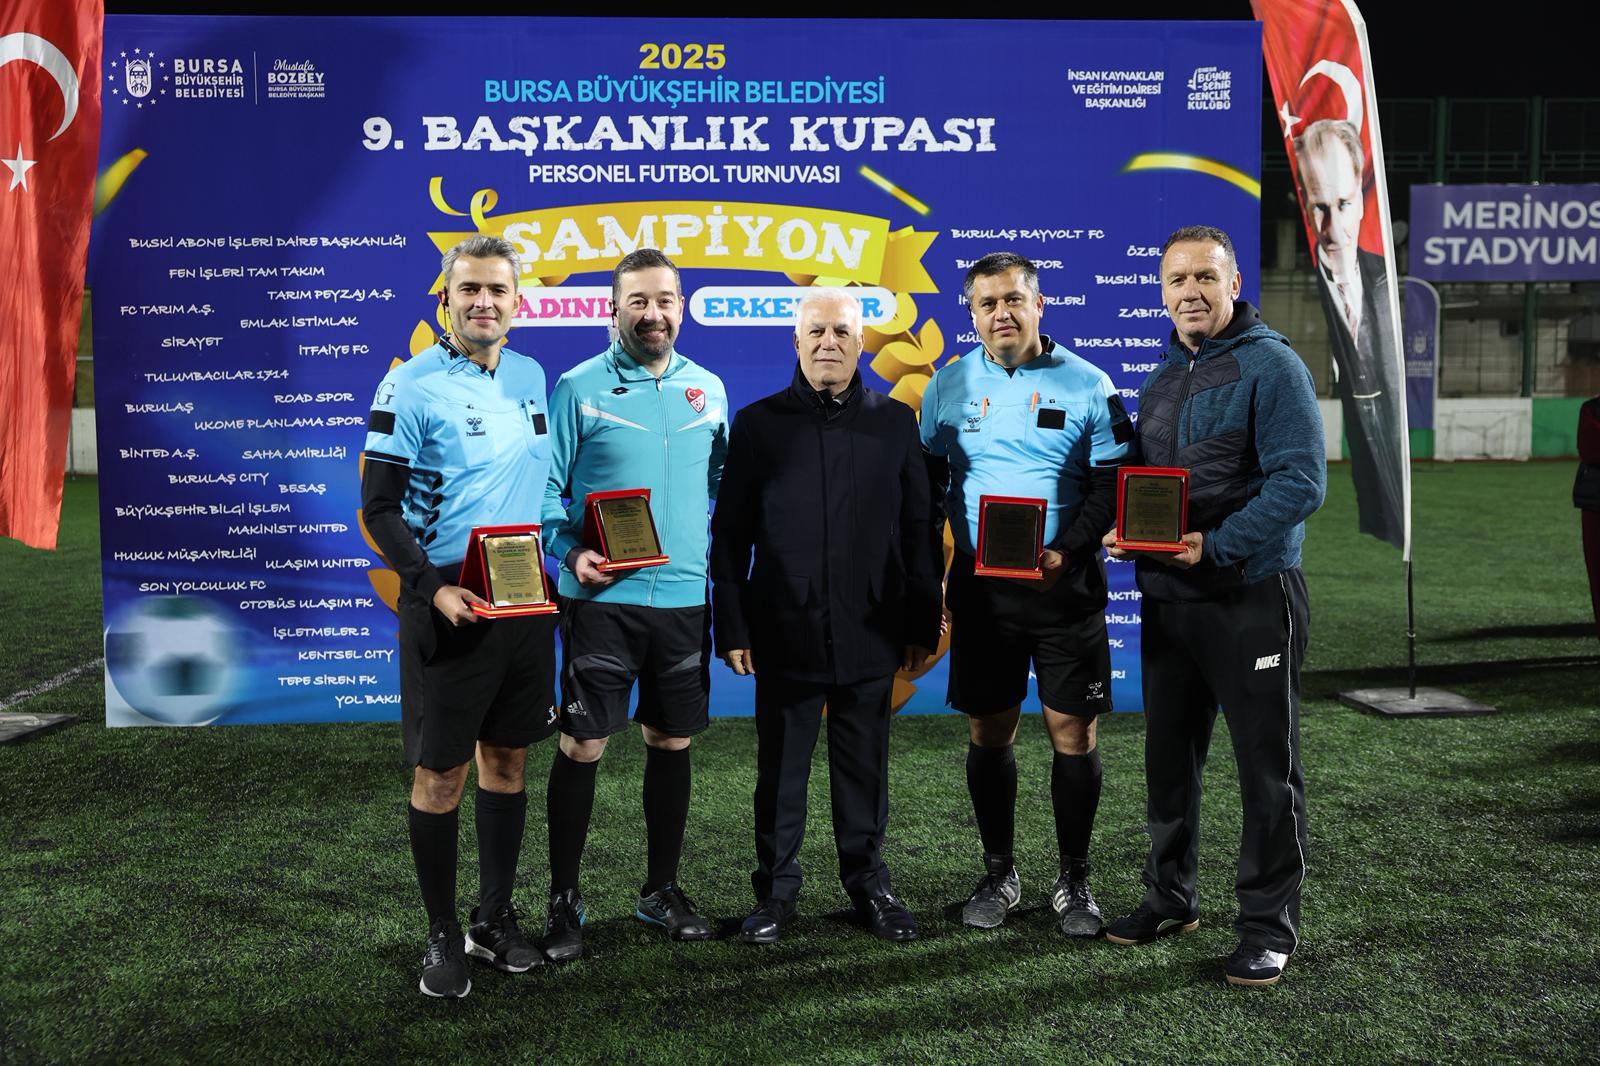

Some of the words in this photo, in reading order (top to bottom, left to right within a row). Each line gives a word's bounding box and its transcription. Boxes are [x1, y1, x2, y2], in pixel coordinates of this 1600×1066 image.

[639, 43, 726, 70] 2025
[174, 59, 243, 73] BURSA
[273, 59, 315, 73] Mustafa
[175, 73, 243, 86] BÜYÜKŞEHİR
[268, 72, 324, 83] BOZBEY
[1068, 68, 1100, 80] İNSAN
[1101, 71, 1164, 80] KAYNAKLARI
[176, 86, 244, 98] BELEDİYESİ
[485, 80, 574, 103] BURSA
[579, 75, 741, 108] BÜYÜKŞEHİR
[746, 75, 886, 104] BELEDİYESİ
[1072, 85, 1085, 94] VE
[1087, 83, 1122, 94] EĞİTİM
[1124, 83, 1161, 94] DAİRESİ
[1085, 98, 1146, 110] BAŞKANLIĞI
[362, 116, 404, 151] 9.
[422, 116, 771, 156] BAŞKANLIK
[791, 116, 996, 153] KUPASI
[530, 165, 635, 184] PERSONEL
[639, 165, 719, 183] FUTBOL
[724, 165, 841, 183] TURNUVASI
[1443, 193, 1600, 229] MERİNOS
[129, 237, 173, 248] BUSKİ
[176, 238, 226, 248] ABONE
[228, 236, 273, 249] İŞLERİ
[276, 237, 318, 247] DAİRE
[320, 235, 406, 249] BAŞKANLIĞI
[503, 206, 870, 273] ŞAMPİYON
[952, 230, 1017, 241] BURULAŞ
[1020, 230, 1083, 243] RAYVOLT
[1088, 230, 1105, 239] FC
[1127, 245, 1163, 257] ÖZEL
[169, 268, 195, 279] FEN
[199, 266, 244, 280] İŞLERİ
[247, 267, 277, 277] TAM
[281, 266, 325, 276] TAKIM
[1095, 275, 1137, 285] BUSKİ
[1141, 274, 1160, 285] BİL
[267, 290, 312, 300] TARIM
[314, 288, 365, 302] PEYZAJ
[368, 288, 395, 300] A.Ş.
[121, 305, 137, 316] FC
[140, 304, 185, 314] TARIM
[187, 303, 215, 315] A.Ş.
[704, 297, 883, 318] ERKER
[1118, 308, 1170, 318] ZABITA
[240, 318, 289, 328] EMLAK
[292, 315, 359, 327] İSTİMLAK
[161, 336, 223, 350] SİRAYET
[1074, 338, 1122, 347] BURSA
[1124, 338, 1162, 347] BBSK
[299, 344, 349, 359] İTFAİYE
[352, 344, 369, 354] FC
[144, 371, 255, 382] TULUMBACILAR
[256, 370, 289, 379] 1714
[274, 393, 313, 403] ROAD
[315, 393, 354, 403] SPOR
[125, 402, 194, 414] BURULAŞ
[195, 420, 244, 430] UKOME
[247, 418, 324, 428] PLANLAMA
[326, 416, 365, 427] SPOR
[120, 448, 169, 459] BİNTED
[172, 449, 199, 460] A.Ş.
[242, 450, 283, 459] SAHA
[285, 447, 346, 459] AMİRLİĞİ
[168, 473, 236, 484] BURULAŞ
[239, 472, 269, 486] CITY
[279, 484, 326, 495] BESAŞ
[115, 504, 208, 519] BÜYÜKŞEHİR
[210, 503, 245, 515] BİLGİ
[248, 503, 290, 515] İŞLEM
[228, 524, 297, 535] MAKİNİST
[299, 524, 348, 534] UNITED
[115, 550, 164, 561] HUKUK
[167, 548, 257, 561] MÜŞAVİRLİĞİ
[265, 559, 319, 570] ULAŞIM
[322, 558, 371, 569] UNITED
[139, 582, 169, 592] SON
[173, 581, 247, 595] YOLCULUK
[250, 580, 266, 590] FC
[240, 599, 296, 610] OTOBÜS
[300, 599, 352, 610] ULAŞIM
[355, 598, 373, 608] FK
[273, 626, 359, 639] İŞLETMELER
[361, 628, 370, 636] 2
[299, 651, 362, 660] KENTSEL
[364, 649, 394, 663] CITY
[1254, 654, 1281, 670] NIKE
[278, 676, 311, 686] TEPE
[313, 674, 356, 685] SİREN
[359, 675, 377, 684] FK
[335, 696, 363, 708] YOL
